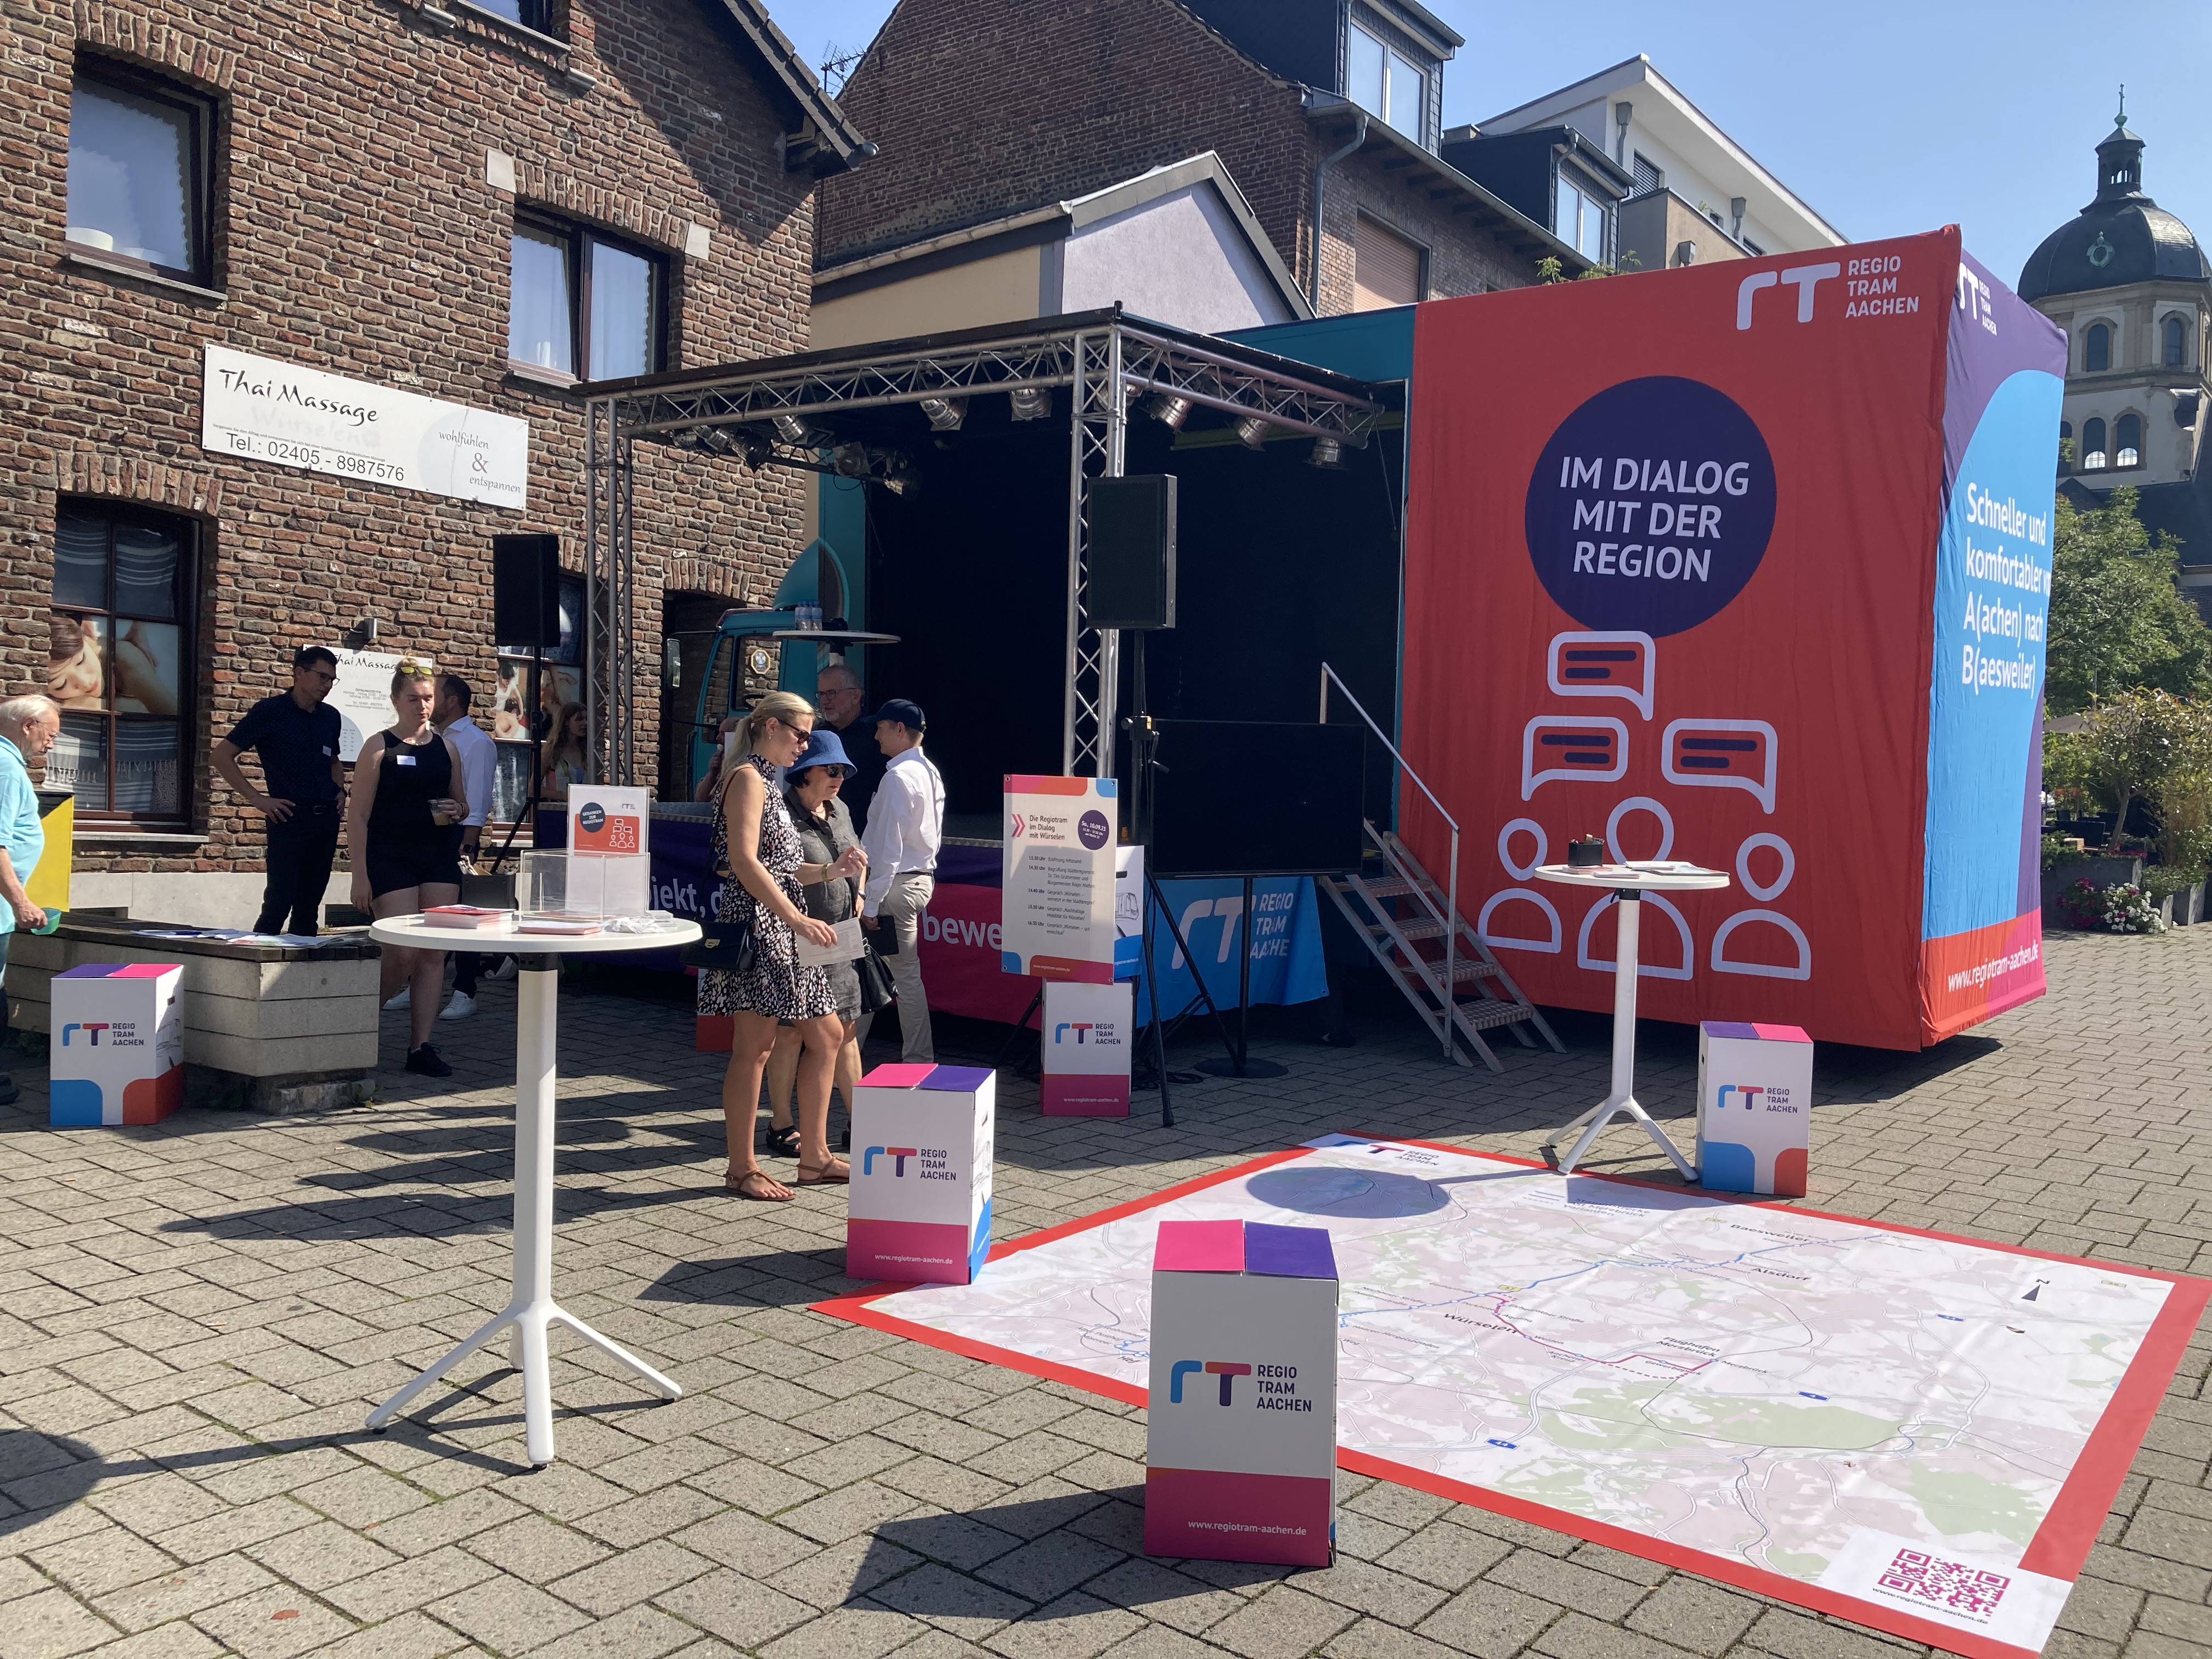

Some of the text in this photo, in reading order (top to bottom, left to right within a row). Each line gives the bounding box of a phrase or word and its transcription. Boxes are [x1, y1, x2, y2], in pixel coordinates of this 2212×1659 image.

[1847, 256, 1901, 276] REGIO
[1847, 276, 1898, 296] TRAM
[1979, 280, 1990, 300] REGIO
[1845, 296, 1920, 318] AACHEN
[1980, 296, 1991, 316] TRAM
[1982, 314, 1997, 336] AACHEN
[218, 369, 379, 426] Thai Massage
[439, 430, 489, 449] wohlfühlen
[226, 432, 261, 453] Tel.:
[268, 441, 319, 464] 02405
[337, 455, 404, 481] 8987576
[472, 453, 489, 474] &
[469, 476, 521, 493] entspannen
[1560, 456, 1750, 496] IM DIALOG
[1572, 499, 1723, 539] MIT DER
[1967, 482, 2046, 546] Schneller und
[1572, 541, 1712, 582] REGION
[1966, 537, 2042, 594] komfortabler
[1963, 591, 2043, 648] A(achen) nach
[356, 658, 396, 674] Massag
[1962, 645, 2035, 699] B(aesweiler)
[1038, 824, 1055, 833] Dialog
[1040, 816, 1068, 824] Regiotram
[1090, 822, 1106, 832] 10.09.23
[1259, 892, 1294, 912] REGIO
[1948, 939, 2039, 992] www.regiotram-aachen.de
[1767, 1087, 1790, 1096] REGIO
[1767, 1096, 1788, 1104] TRAM
[1767, 1105, 1798, 1114] AACHEN
[921, 1149, 947, 1159] REGIO
[1394, 1156, 1440, 1166] AACHEN
[921, 1160, 945, 1169] TRAM
[920, 1171, 956, 1181] AACHEN
[1730, 1224, 1811, 1242] Baesweiler
[874, 1254, 953, 1265] www.regiotram-aachen.de
[1751, 1268, 1813, 1280] Alsdorf
[1443, 1313, 1518, 1334] Würselen
[1559, 1314, 1585, 1323] Straße
[1656, 1341, 1718, 1357] Merzbrück
[1662, 1336, 1721, 1352] Flughafen
[1257, 1364, 1297, 1379] REGIO
[1722, 1361, 1768, 1374] Merzbrück
[1257, 1380, 1295, 1395] TRAM
[1256, 1397, 1312, 1412] AACHEN
[1187, 1520, 1307, 1536] www.regiotram-aachen.de
[1872, 1587, 1989, 1624] www.regiotram-aachen.de
